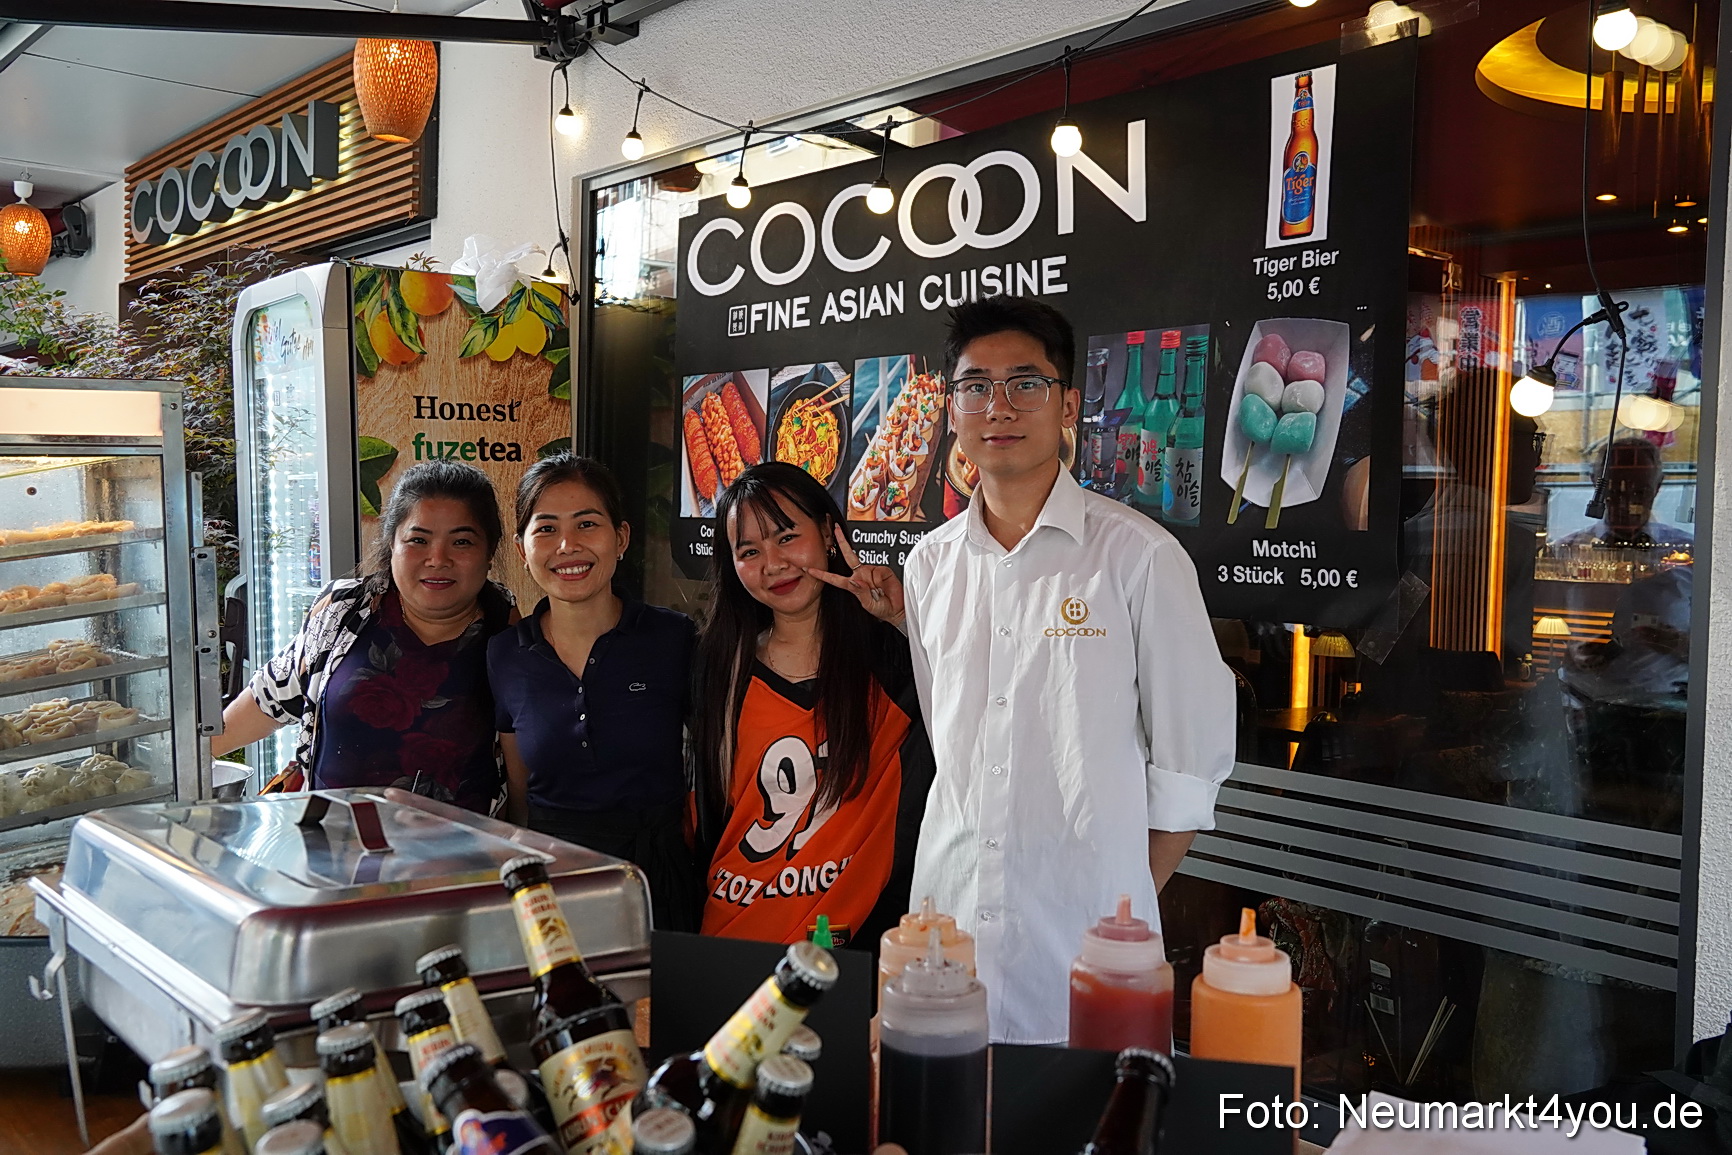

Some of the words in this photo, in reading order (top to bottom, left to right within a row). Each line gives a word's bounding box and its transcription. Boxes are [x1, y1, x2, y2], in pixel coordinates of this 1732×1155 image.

[131, 100, 326, 245] COCOON
[1286, 173, 1315, 195] Tiger
[687, 119, 1147, 297] COCOON
[1252, 256, 1298, 278] Tiger
[1301, 248, 1340, 269] Bier
[749, 296, 811, 334] FINE
[819, 280, 905, 325] ASIAN
[919, 254, 1068, 312] CUISINE
[1266, 278, 1304, 302] 5,00
[1308, 276, 1321, 295] €
[412, 395, 522, 422] Honest
[411, 432, 522, 462] fuzetea
[695, 543, 714, 556] Stüc
[852, 528, 897, 547] Crunchy
[899, 529, 931, 545] Sus
[1252, 539, 1317, 559] Motchi
[858, 549, 889, 565] Stück
[1217, 564, 1229, 583] 3
[1233, 565, 1285, 585] Stück
[1300, 568, 1341, 590] 5,00
[1345, 569, 1359, 588] €
[1044, 627, 1107, 638] COCOON
